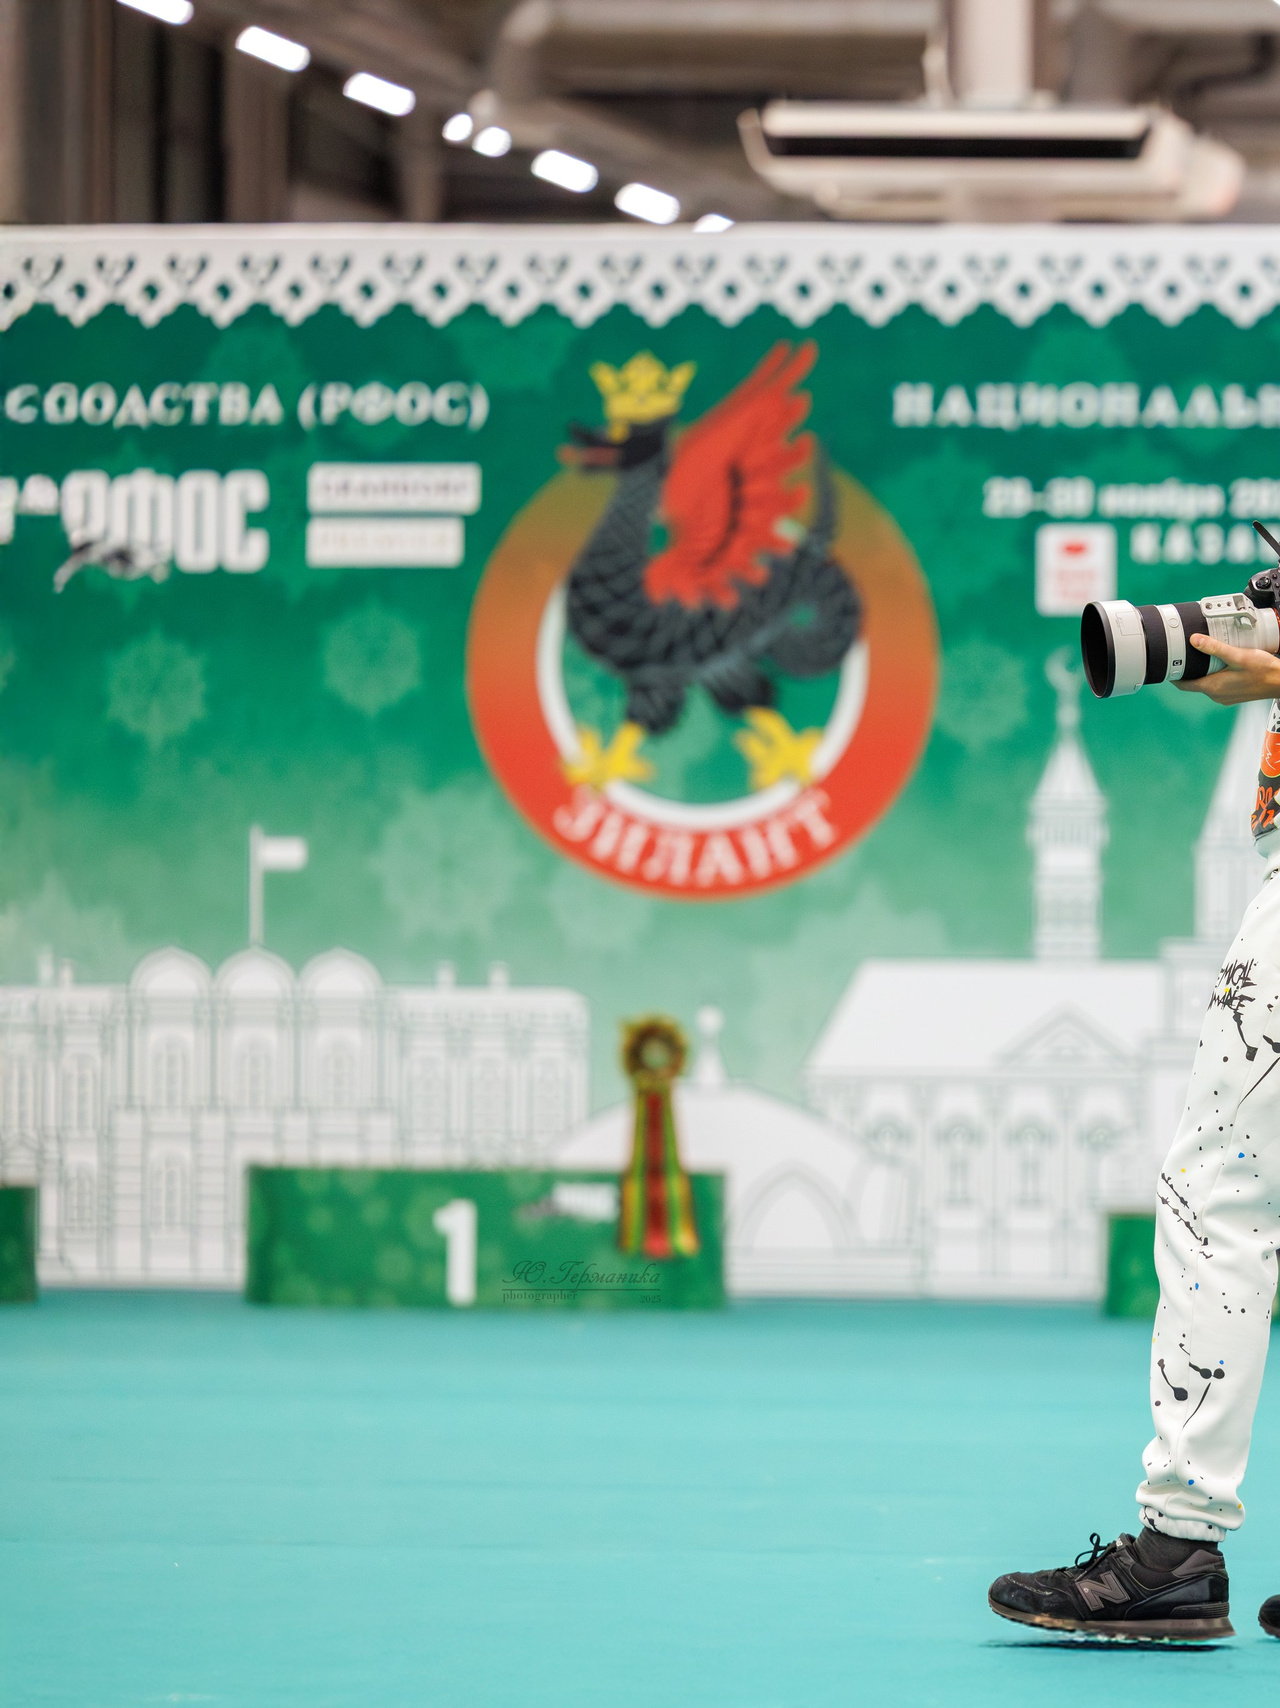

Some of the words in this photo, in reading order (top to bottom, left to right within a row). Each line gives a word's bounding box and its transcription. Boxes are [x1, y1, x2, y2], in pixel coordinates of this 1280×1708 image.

[297, 381, 489, 430] (РФОС)
[552, 784, 841, 887] ЗИЛАНТ
[433, 1199, 477, 1306] 1
